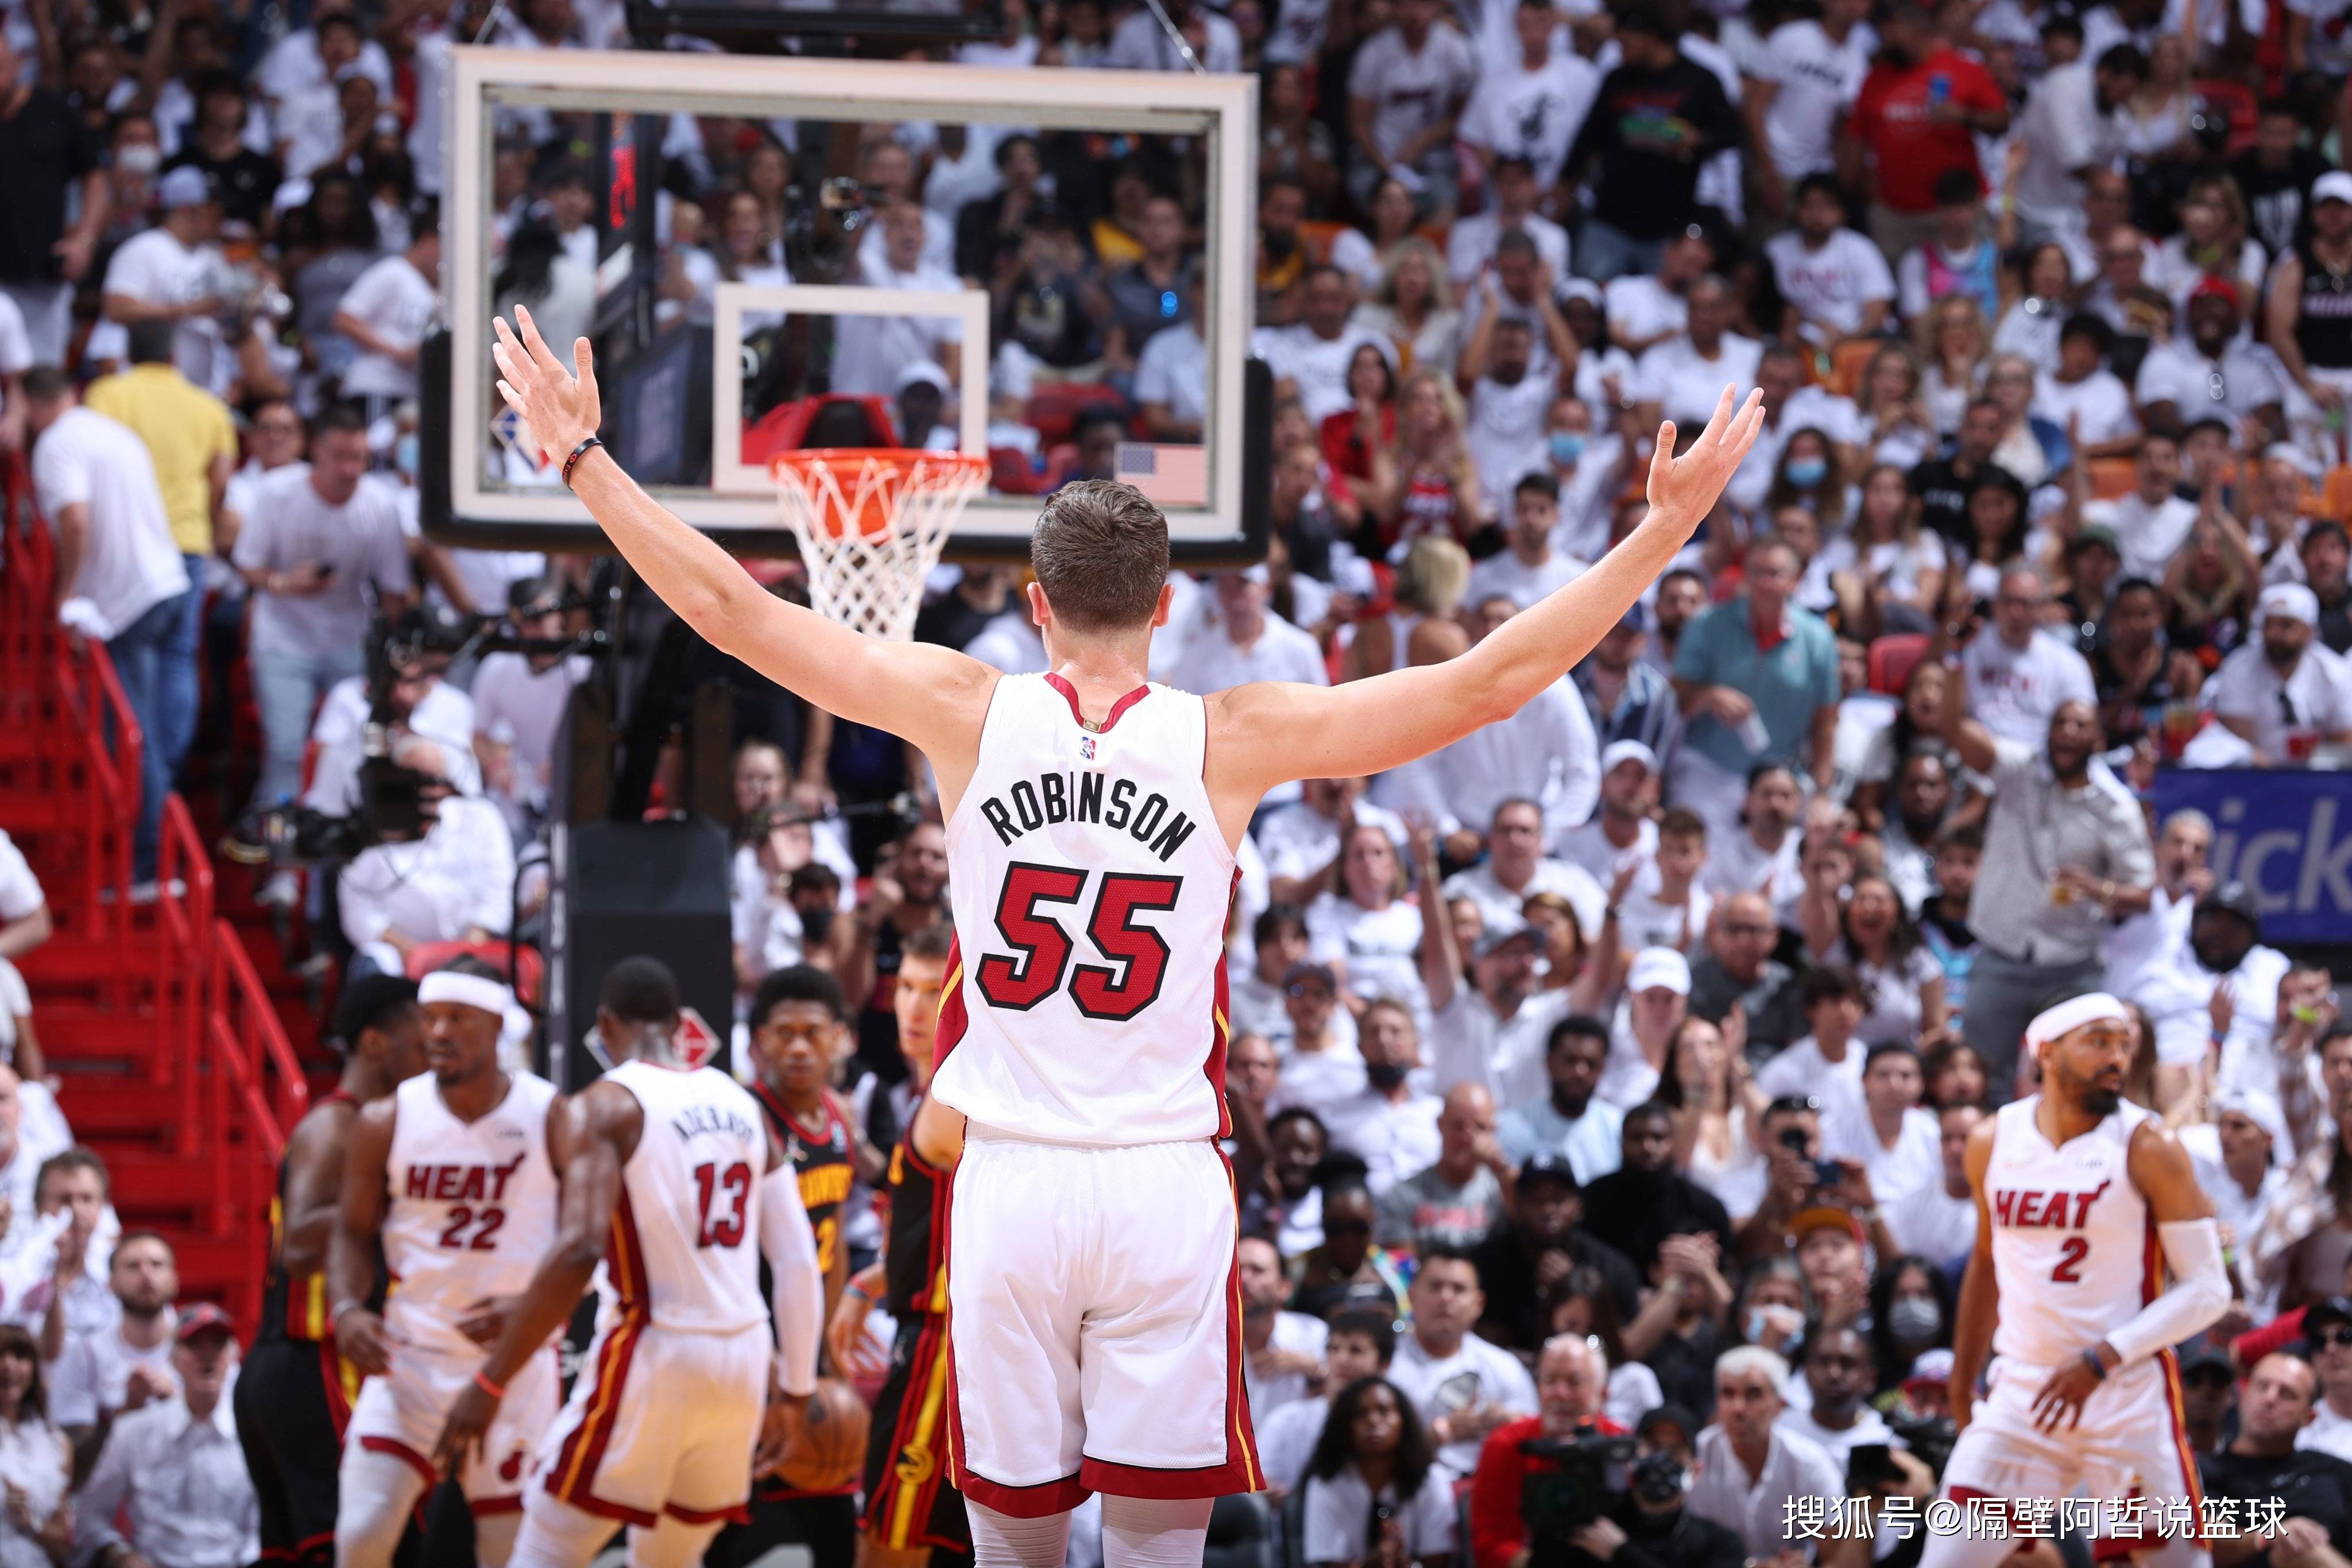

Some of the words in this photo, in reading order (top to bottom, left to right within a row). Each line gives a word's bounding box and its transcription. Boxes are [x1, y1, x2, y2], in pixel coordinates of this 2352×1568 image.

[980, 771, 1197, 862] ROBINSON
[975, 861, 1184, 1021] 55
[406, 1151, 526, 1201] HEAT
[439, 1206, 506, 1250] 22
[694, 1162, 752, 1248] 13
[1995, 1178, 2111, 1229] HEAT
[2051, 1236, 2089, 1283] 2
